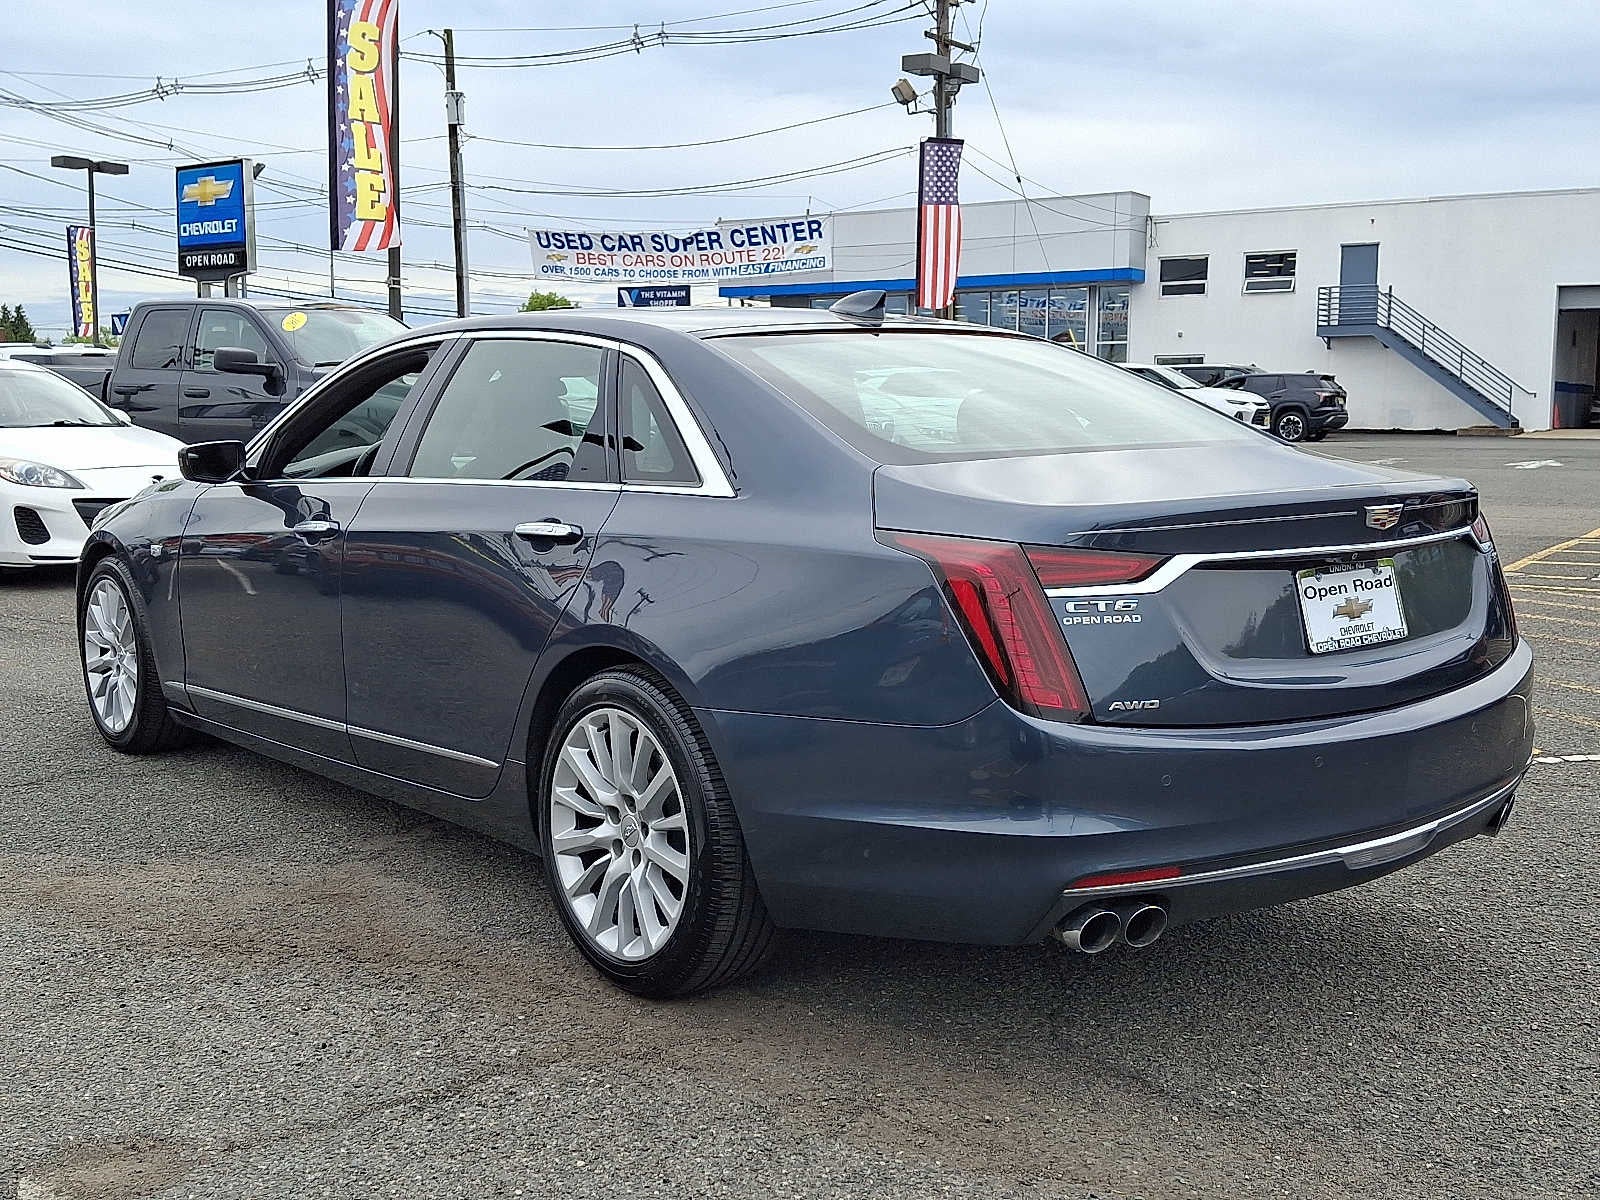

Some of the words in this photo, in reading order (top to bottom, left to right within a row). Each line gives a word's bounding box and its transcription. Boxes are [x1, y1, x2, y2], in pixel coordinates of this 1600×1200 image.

[348, 21, 388, 222] SALE
[180, 219, 238, 237] CHEVROLET
[535, 231, 594, 251] USED
[600, 234, 646, 253] CAR
[650, 230, 723, 252] SUPER
[729, 219, 824, 248] CENTER
[186, 254, 209, 267] OPEN
[211, 253, 235, 266] ROAD
[576, 252, 617, 266] BEST
[622, 254, 666, 267] CARS
[670, 253, 695, 267] ON
[700, 249, 757, 266] ROUTE
[761, 246, 785, 261] 22!
[541, 265, 566, 275] OVER
[569, 267, 591, 276] 1500
[594, 268, 620, 278] CARS
[622, 269, 636, 278] TO
[636, 269, 679, 279] CHOOSE
[681, 268, 710, 279] FROM
[711, 266, 738, 277] WITH
[740, 262, 767, 276] EASY
[768, 257, 826, 273] FINANCING
[76, 239, 94, 324] SALE
[641, 291, 655, 299] THE
[656, 290, 686, 298] VITAMIN
[1355, 562, 1365, 570] NJ
[1304, 583, 1348, 601] Open
[1352, 575, 1393, 592] Road
[1065, 599, 1139, 613] CT6
[1063, 616, 1101, 625] OPEN
[1103, 614, 1142, 624] ROAD
[1339, 622, 1374, 637] CHEVROLET
[1317, 640, 1340, 653] OPEN
[1340, 637, 1362, 649] ROAD
[1362, 628, 1406, 645] CHEVROLET
[1109, 699, 1160, 711] AWD
